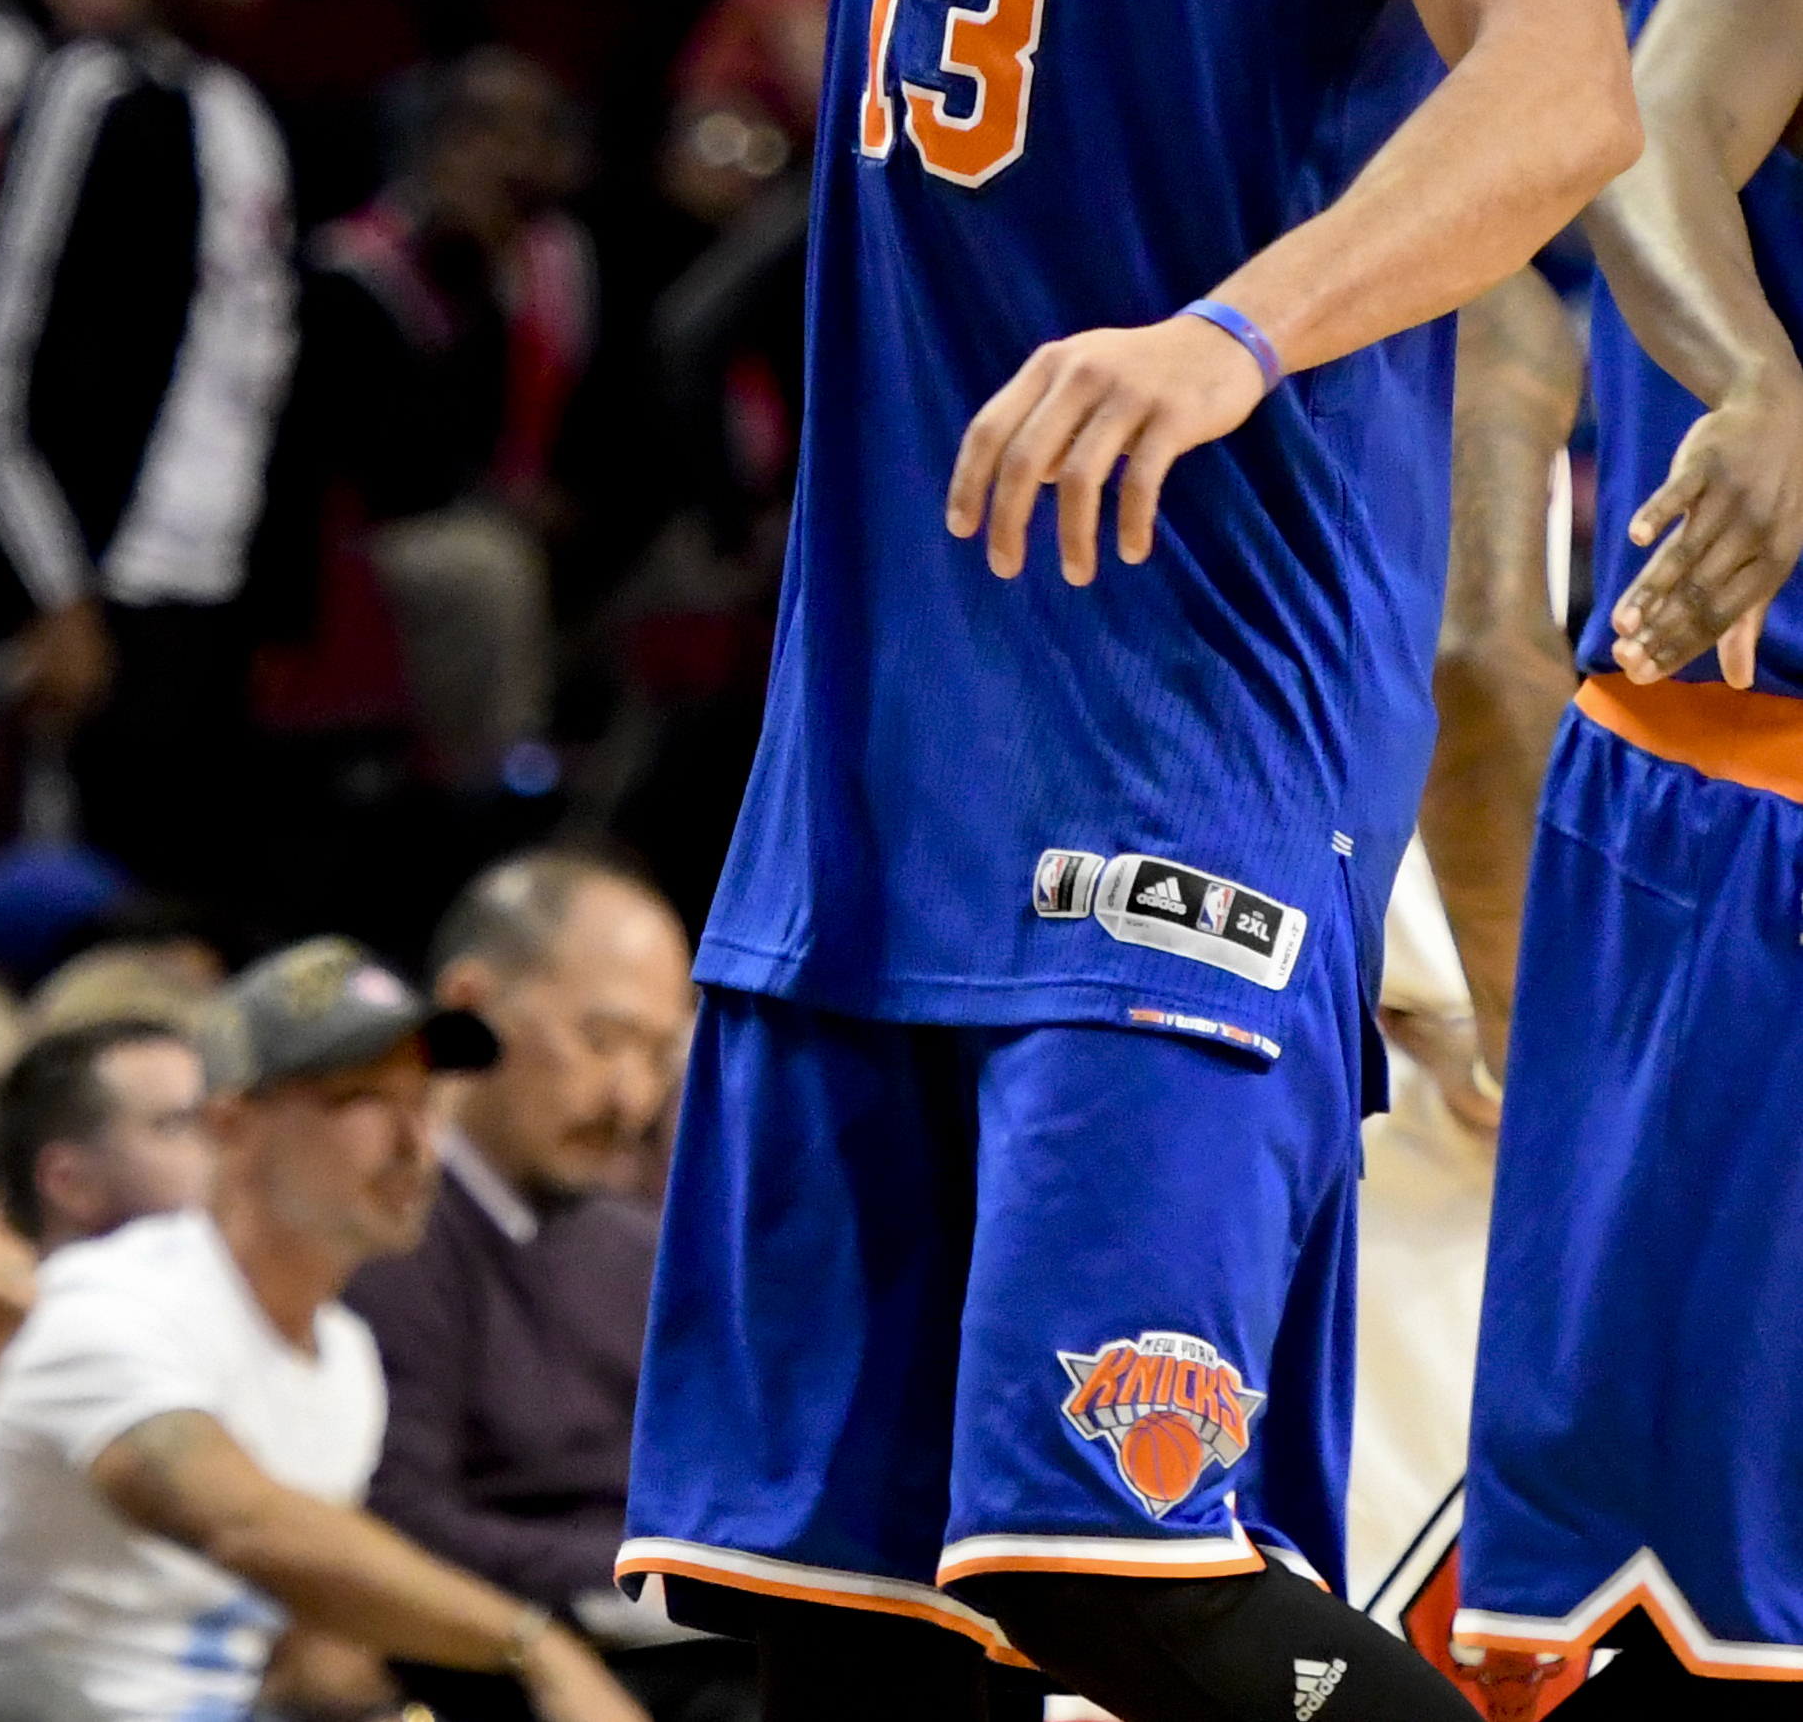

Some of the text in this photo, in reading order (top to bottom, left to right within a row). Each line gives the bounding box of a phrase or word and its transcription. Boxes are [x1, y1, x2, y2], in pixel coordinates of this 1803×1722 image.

[1136, 892, 1187, 916] adidas
[1236, 912, 1271, 943] 2XL
[1070, 1346, 1246, 1449] KNICKS
[1296, 1658, 1348, 1722] adidas
